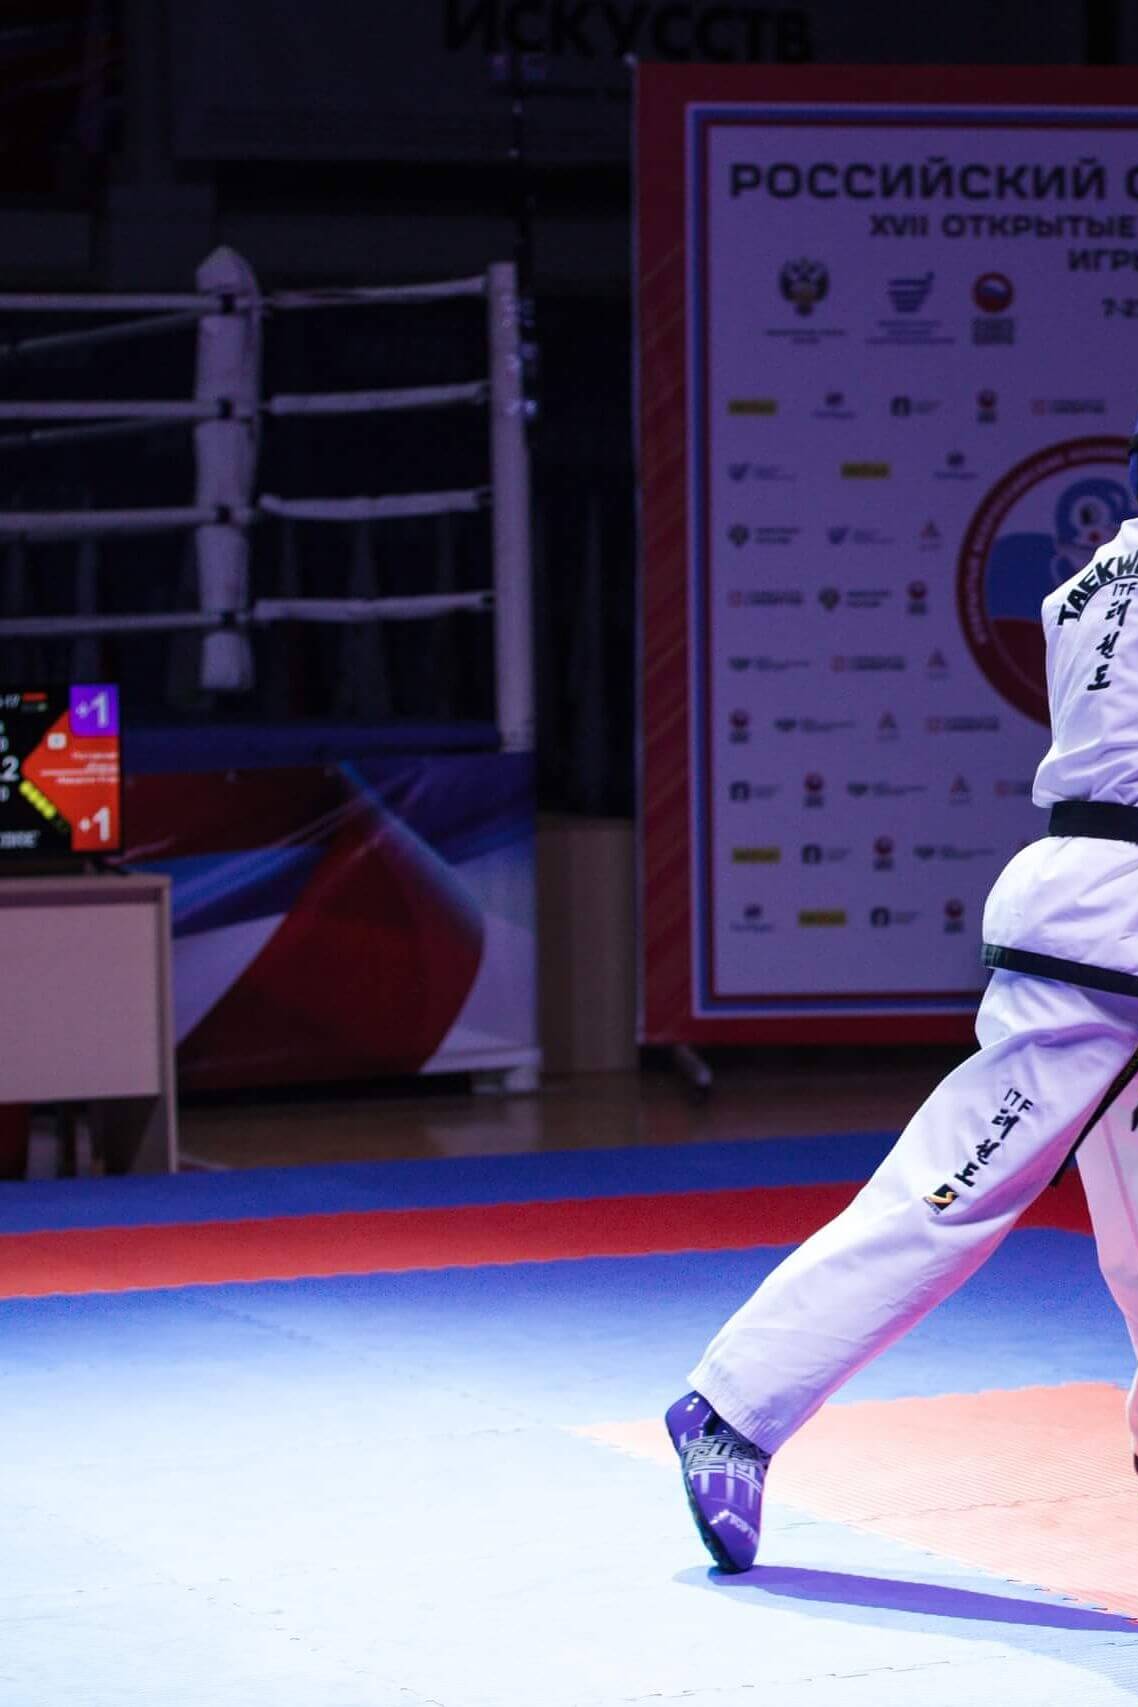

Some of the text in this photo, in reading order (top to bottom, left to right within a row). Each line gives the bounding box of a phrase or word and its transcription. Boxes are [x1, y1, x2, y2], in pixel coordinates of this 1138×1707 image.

[730, 157, 1105, 199] РОССИЙСКИЙ
[869, 214, 928, 238] XVII
[942, 214, 1136, 239] ОТКРЫТЫЕ
[1113, 582, 1138, 596] ITF
[1004, 1088, 1034, 1112] ITF
